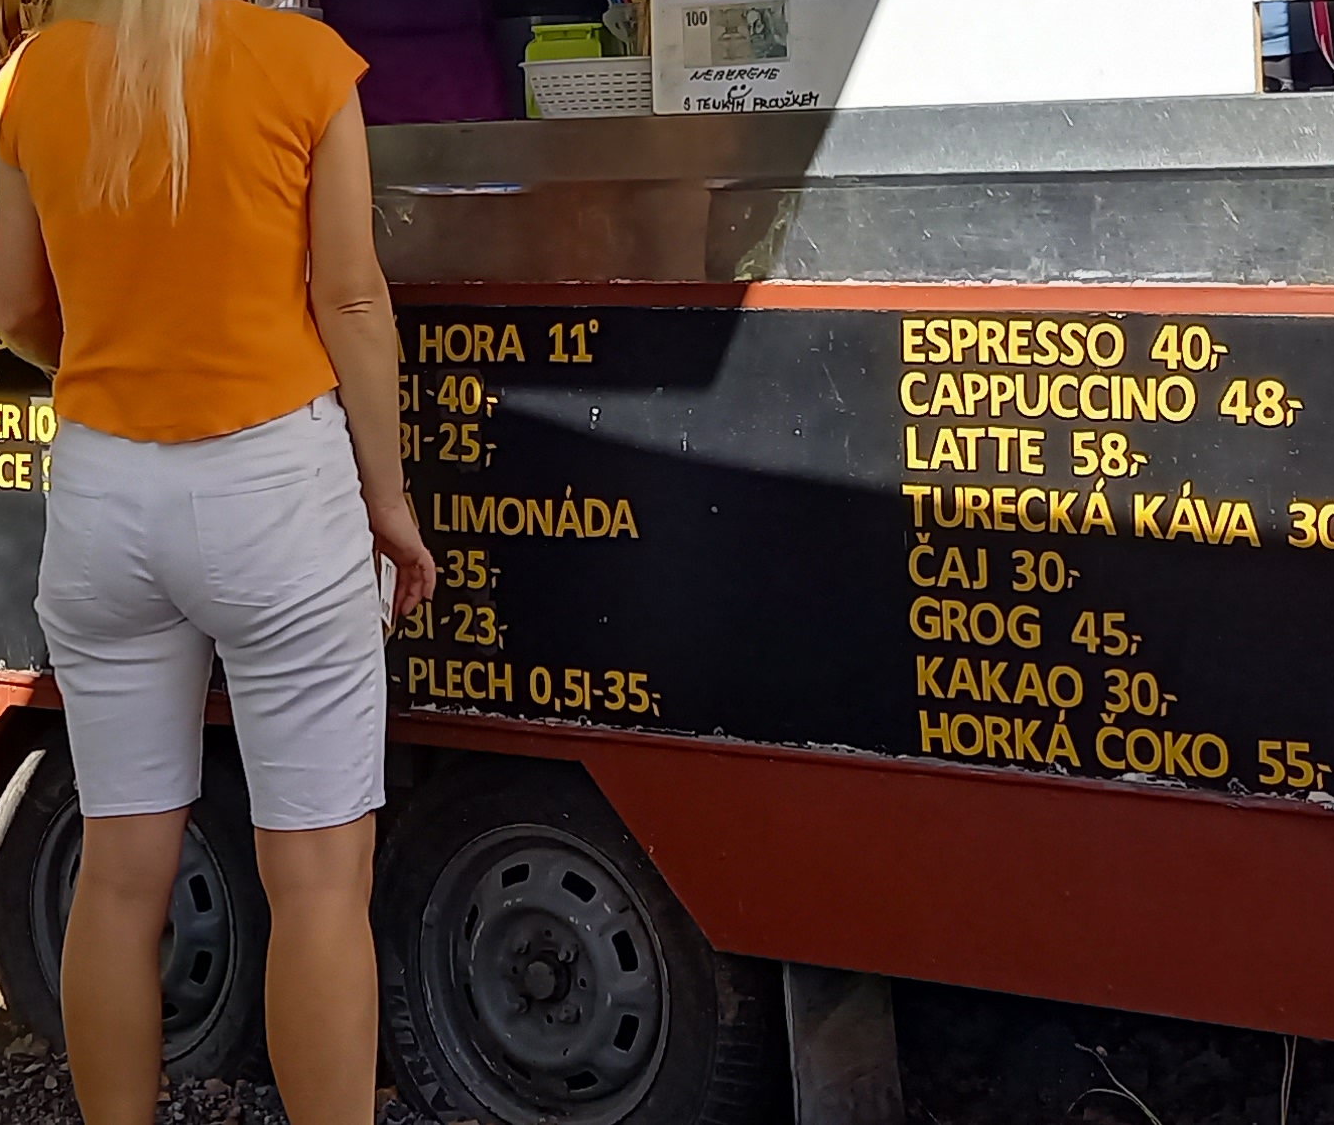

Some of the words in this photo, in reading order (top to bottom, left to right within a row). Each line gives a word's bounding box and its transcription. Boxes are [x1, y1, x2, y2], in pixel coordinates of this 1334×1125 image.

[685, 10, 708, 27] 100
[689, 67, 780, 81] NEBEREME
[753, 90, 819, 111] PROUŽKEM
[419, 323, 525, 363] HORA
[548, 319, 599, 363] 11°
[901, 319, 1125, 368] ESPRESSO
[1150, 325, 1229, 371] 40,-
[900, 372, 1196, 422] CAPPUCCINO
[1219, 380, 1305, 427] 48,-
[904, 426, 1046, 475] LATTE
[1071, 431, 1152, 478] 58,-
[433, 484, 639, 539] LIMONÁDA
[902, 477, 1117, 536] TURECKÁ
[1133, 480, 1262, 549] KÁVA
[908, 532, 988, 590] ČAJ
[1010, 549, 1081, 593] 30,-
[909, 596, 1042, 648] GROG
[1070, 612, 1143, 656] 45,-
[408, 657, 513, 702] PLECH
[915, 654, 1083, 708] KAKAO
[1104, 669, 1179, 717] 30,-
[918, 709, 1081, 768] HORKÁ
[1096, 711, 1229, 777] ČOKO
[1257, 739, 1332, 789] 55,-
